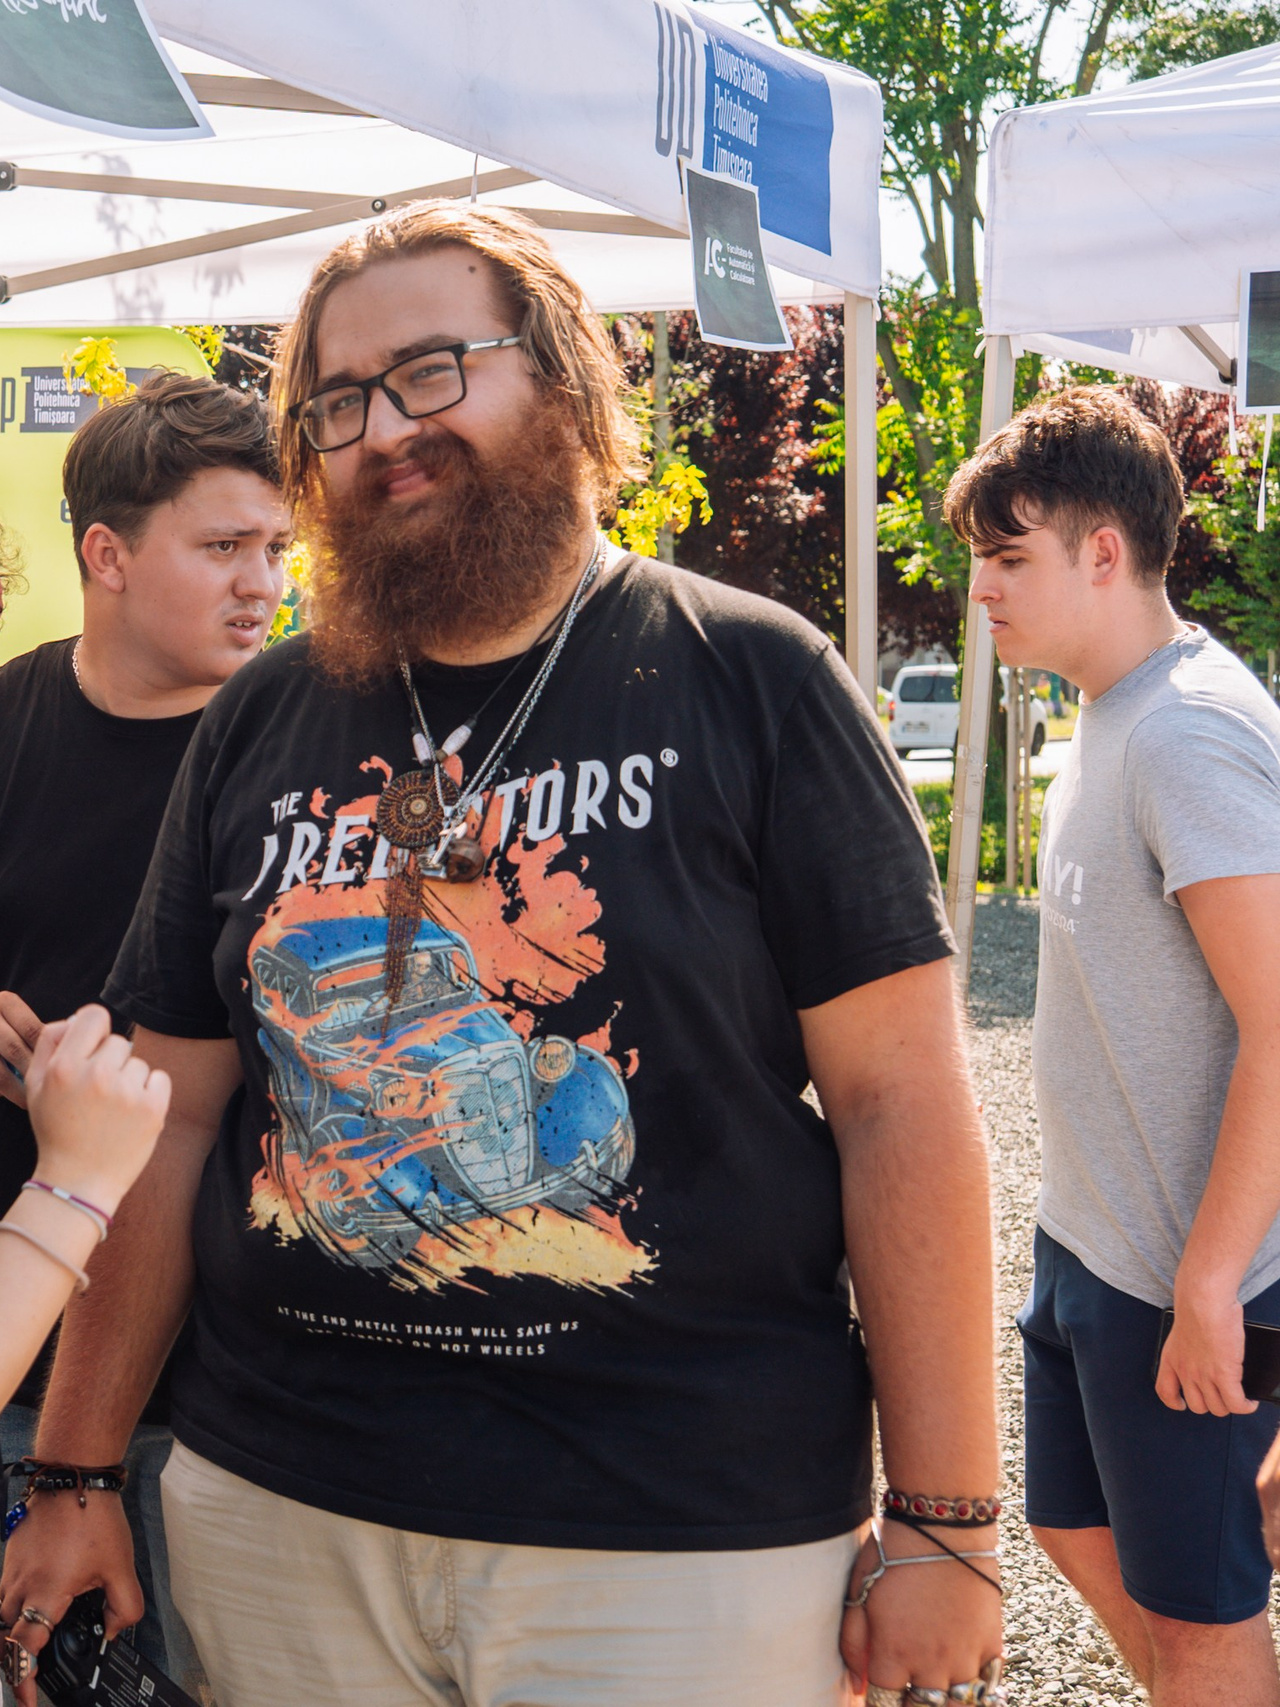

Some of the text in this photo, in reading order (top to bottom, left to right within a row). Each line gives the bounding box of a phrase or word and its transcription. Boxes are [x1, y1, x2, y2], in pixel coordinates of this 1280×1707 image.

[709, 33, 768, 103] Universitatea
[713, 83, 758, 147] Politehnica
[33, 392, 80, 407] Politehnica
[270, 791, 303, 825] THE
[294, 1310, 316, 1322] THE
[322, 1314, 347, 1327] END
[354, 1319, 398, 1333] METAL
[405, 1324, 463, 1337] THRASH
[471, 1327, 508, 1338] WILL
[516, 1322, 552, 1338] SAVE
[560, 1320, 579, 1332] US
[441, 1342, 470, 1354] HOT
[480, 1344, 546, 1356] WHEELS
